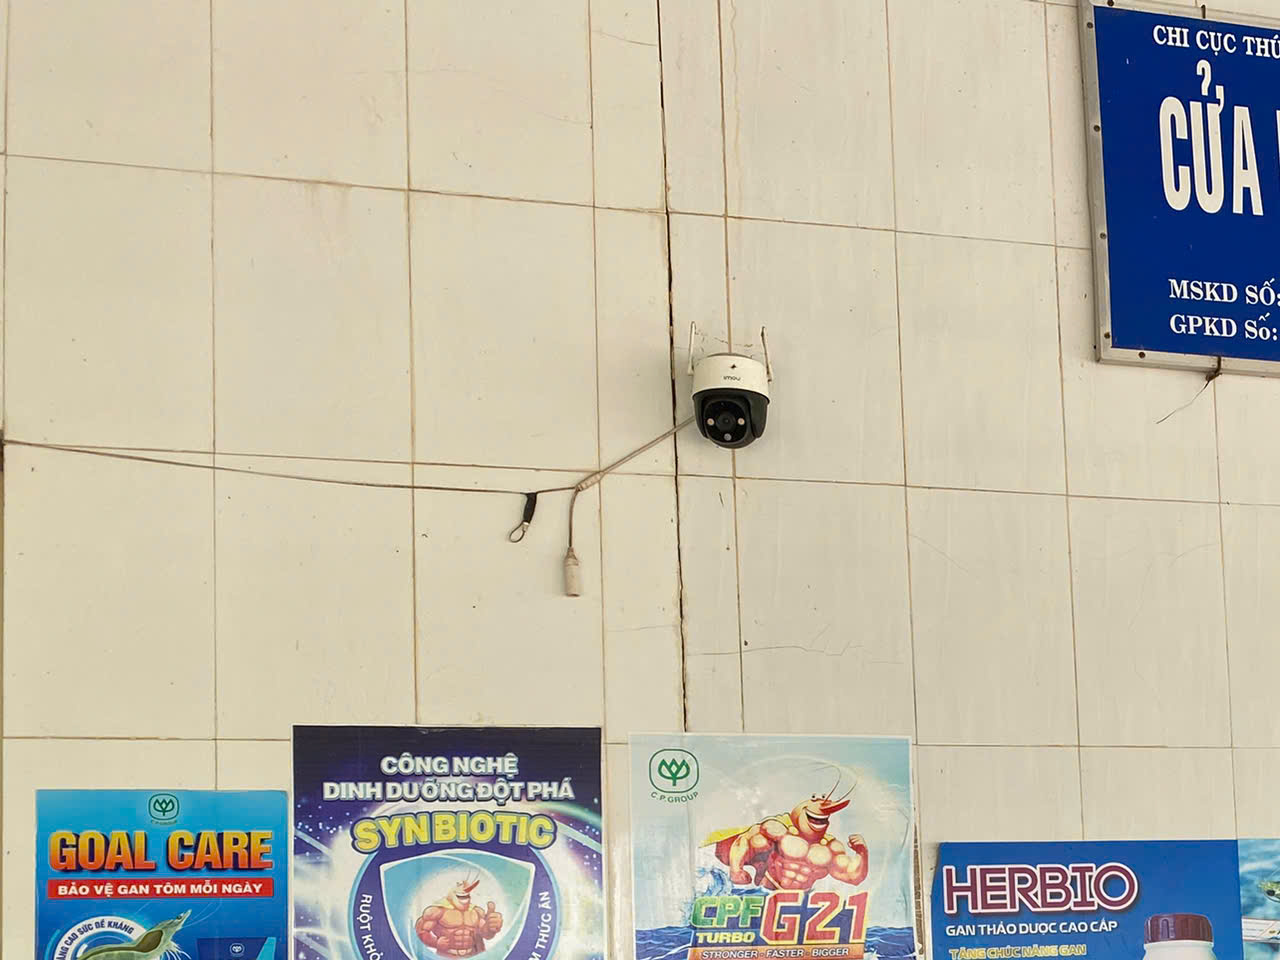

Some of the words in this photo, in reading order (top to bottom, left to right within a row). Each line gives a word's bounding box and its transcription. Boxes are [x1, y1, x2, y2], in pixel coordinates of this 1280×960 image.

[1153, 25, 1189, 48] CHI
[1196, 30, 1236, 56] CỤC
[1243, 34, 1280, 59] THÚ
[1159, 60, 1264, 217] CỬA
[1168, 279, 1238, 303] MSKD
[1170, 314, 1237, 337] GPKD
[1245, 313, 1278, 341] Số:
[381, 752, 448, 775] CÔNG
[452, 752, 518, 780] NGHỆ
[323, 782, 382, 800] DINH
[391, 779, 472, 799] DƯỠNG
[477, 778, 524, 805] ĐỘT
[528, 777, 575, 800] PHÁ
[49, 831, 156, 870] GOAL
[168, 831, 272, 870] CARE
[58, 880, 90, 896] BẢO
[94, 884, 113, 898] VỆ
[117, 884, 149, 895] GAN
[155, 882, 187, 894] TÔM
[190, 879, 218, 894] MỖI
[221, 880, 263, 894] NGÀY
[943, 862, 1139, 914] HERBIO
[356, 894, 373, 931] RUỘT
[691, 896, 764, 928] CPF
[760, 890, 869, 945] G21
[696, 932, 756, 943] TURBO
[946, 924, 975, 937] GAN
[978, 921, 1016, 936] THẢO
[1019, 920, 1057, 937] DƯỢC
[1059, 921, 1088, 933] CAO
[1090, 917, 1118, 933] CẤP
[702, 948, 758, 959] STRONGER
[766, 948, 804, 958] FASTER
[812, 947, 849, 957] BIGGER
